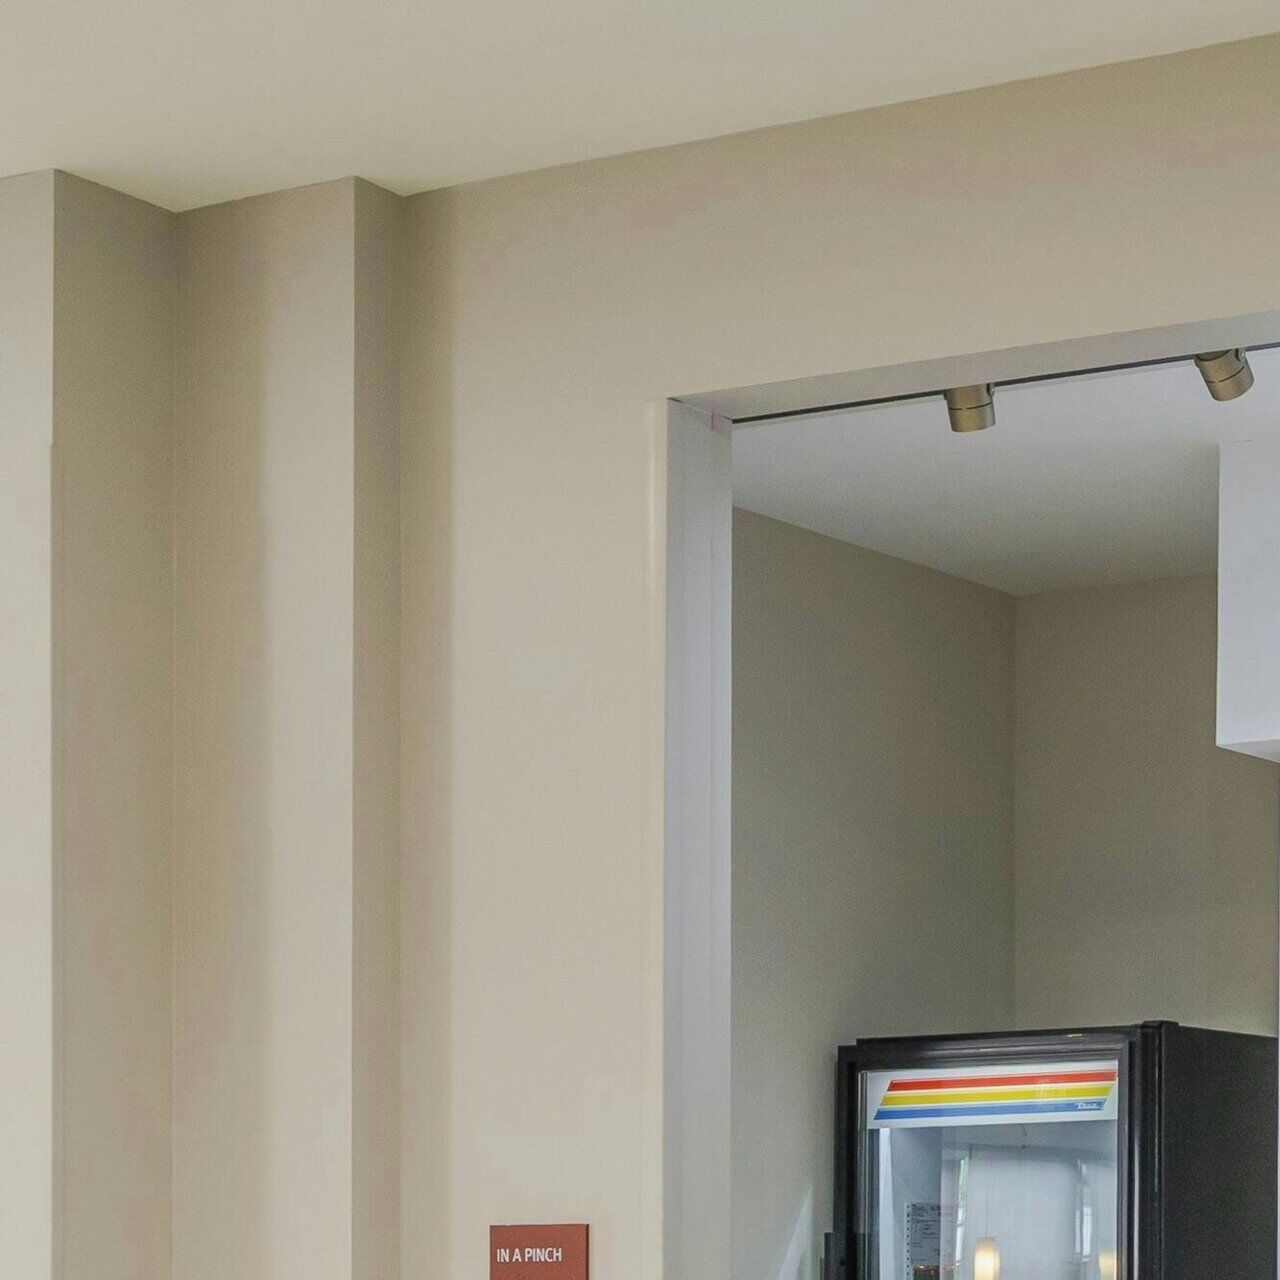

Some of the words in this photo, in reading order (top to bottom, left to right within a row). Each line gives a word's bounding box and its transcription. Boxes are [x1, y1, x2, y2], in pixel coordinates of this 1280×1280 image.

[497, 1249, 509, 1262] IN
[512, 1248, 522, 1262] A
[525, 1247, 562, 1262] PINCH
